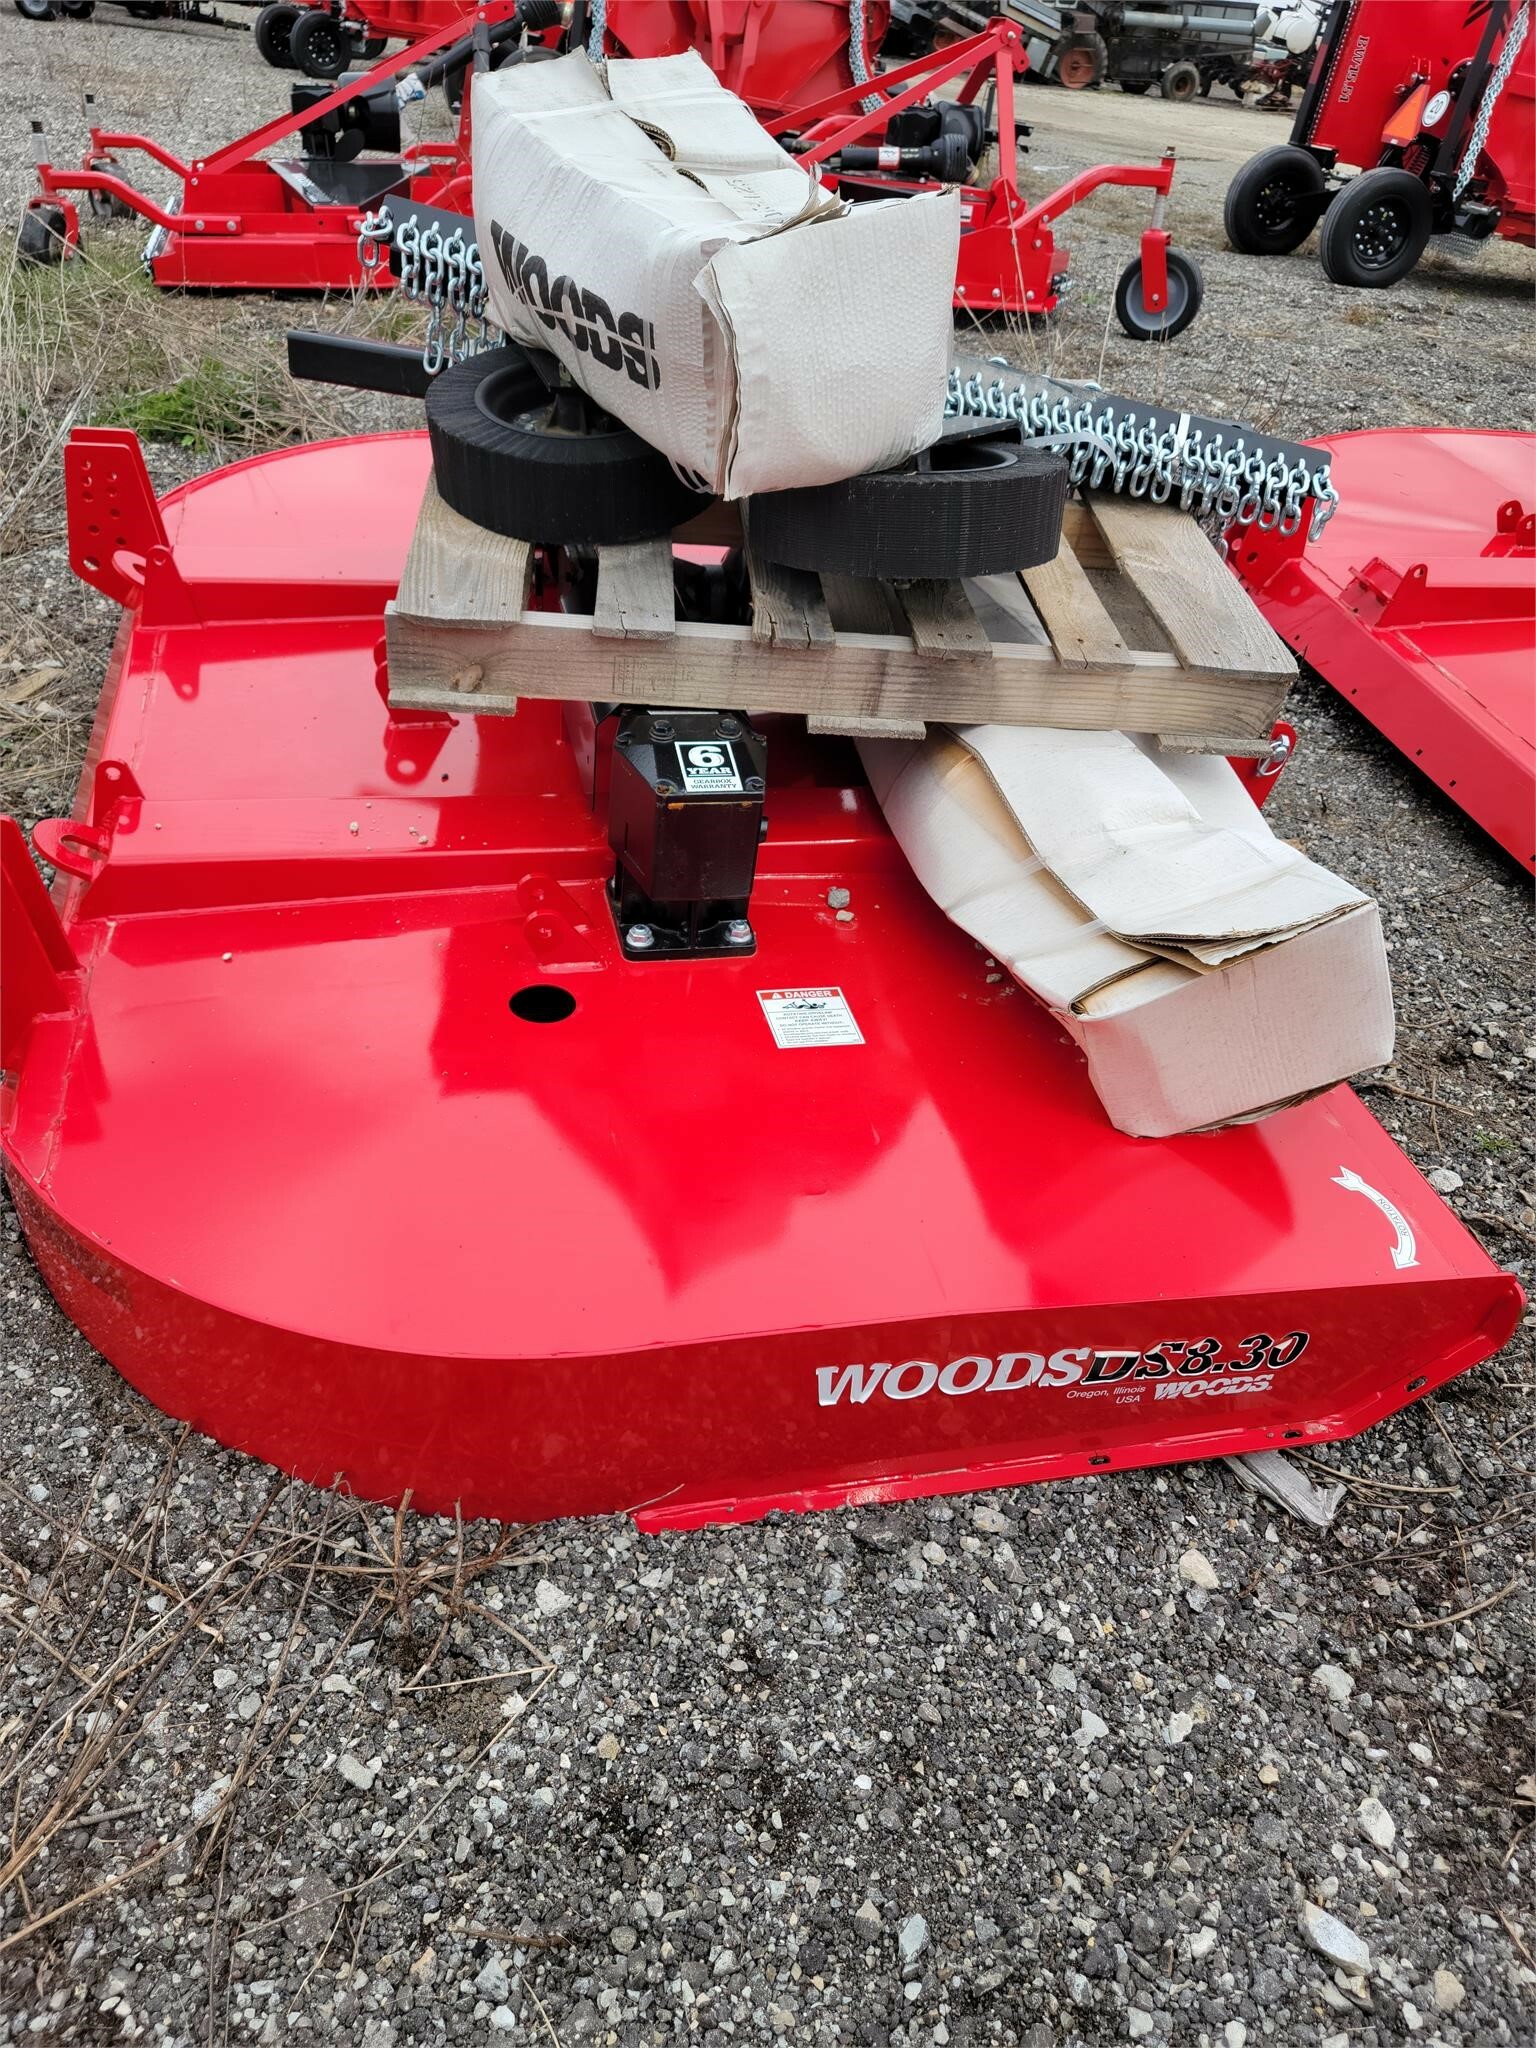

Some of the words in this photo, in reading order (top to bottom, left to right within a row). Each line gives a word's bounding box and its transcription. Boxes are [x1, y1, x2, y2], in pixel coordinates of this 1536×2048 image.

[1429, 99, 1444, 114] 20
[491, 219, 661, 391] WOODS
[687, 745, 725, 768] 6
[686, 767, 733, 775] YEAR
[785, 990, 832, 999] DANGER
[1378, 1199, 1409, 1237] ROTATION
[815, 1347, 1091, 1406] WOODS
[1081, 1330, 1310, 1386] DS8.30
[1066, 1388, 1110, 1399] Oregon,
[1113, 1385, 1147, 1396] Illinois
[1154, 1373, 1275, 1401] WOODS
[1116, 1396, 1141, 1404] USA
